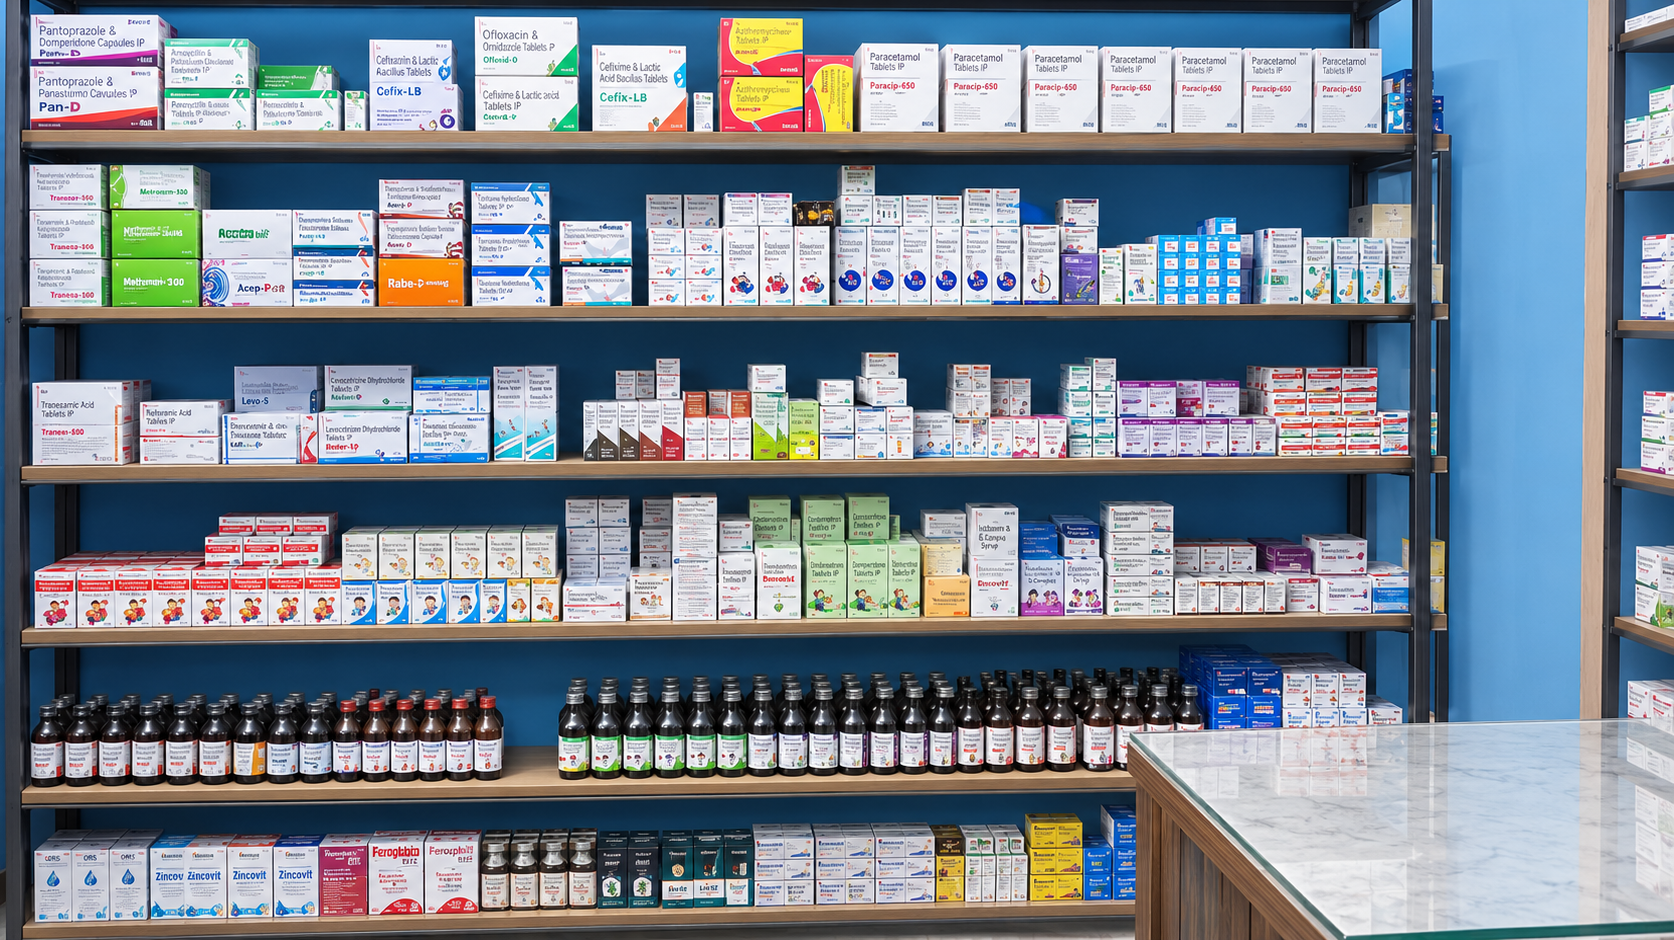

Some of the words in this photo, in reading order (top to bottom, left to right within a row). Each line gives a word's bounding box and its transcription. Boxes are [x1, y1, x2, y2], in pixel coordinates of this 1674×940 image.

[39, 25, 106, 37] Pantoprazole
[109, 26, 116, 36] &
[483, 29, 528, 40] Ofloxacin
[532, 30, 538, 39] &
[39, 38, 95, 49] Domperidone
[870, 53, 920, 61] Paracetamol
[954, 54, 1003, 62] Paracetamol
[1035, 55, 1082, 63] Paracetamol
[1110, 55, 1156, 64] Paracetamol
[1182, 56, 1227, 65] Paracetamol
[1251, 56, 1297, 65] Paracetamol
[1322, 56, 1367, 65] Paracetamol
[38, 77, 104, 88] Pantoprazole
[106, 77, 113, 87] &
[870, 82, 915, 90] Paracip-650
[954, 83, 998, 91] Paracip-650
[1035, 83, 1077, 92] Paracip-650
[600, 92, 647, 103] Cefix-LB
[39, 102, 81, 113] Pan-D
[187, 872, 221, 881] Zincovit
[233, 870, 267, 880] Zincovit
[279, 870, 313, 880] Zincovit
